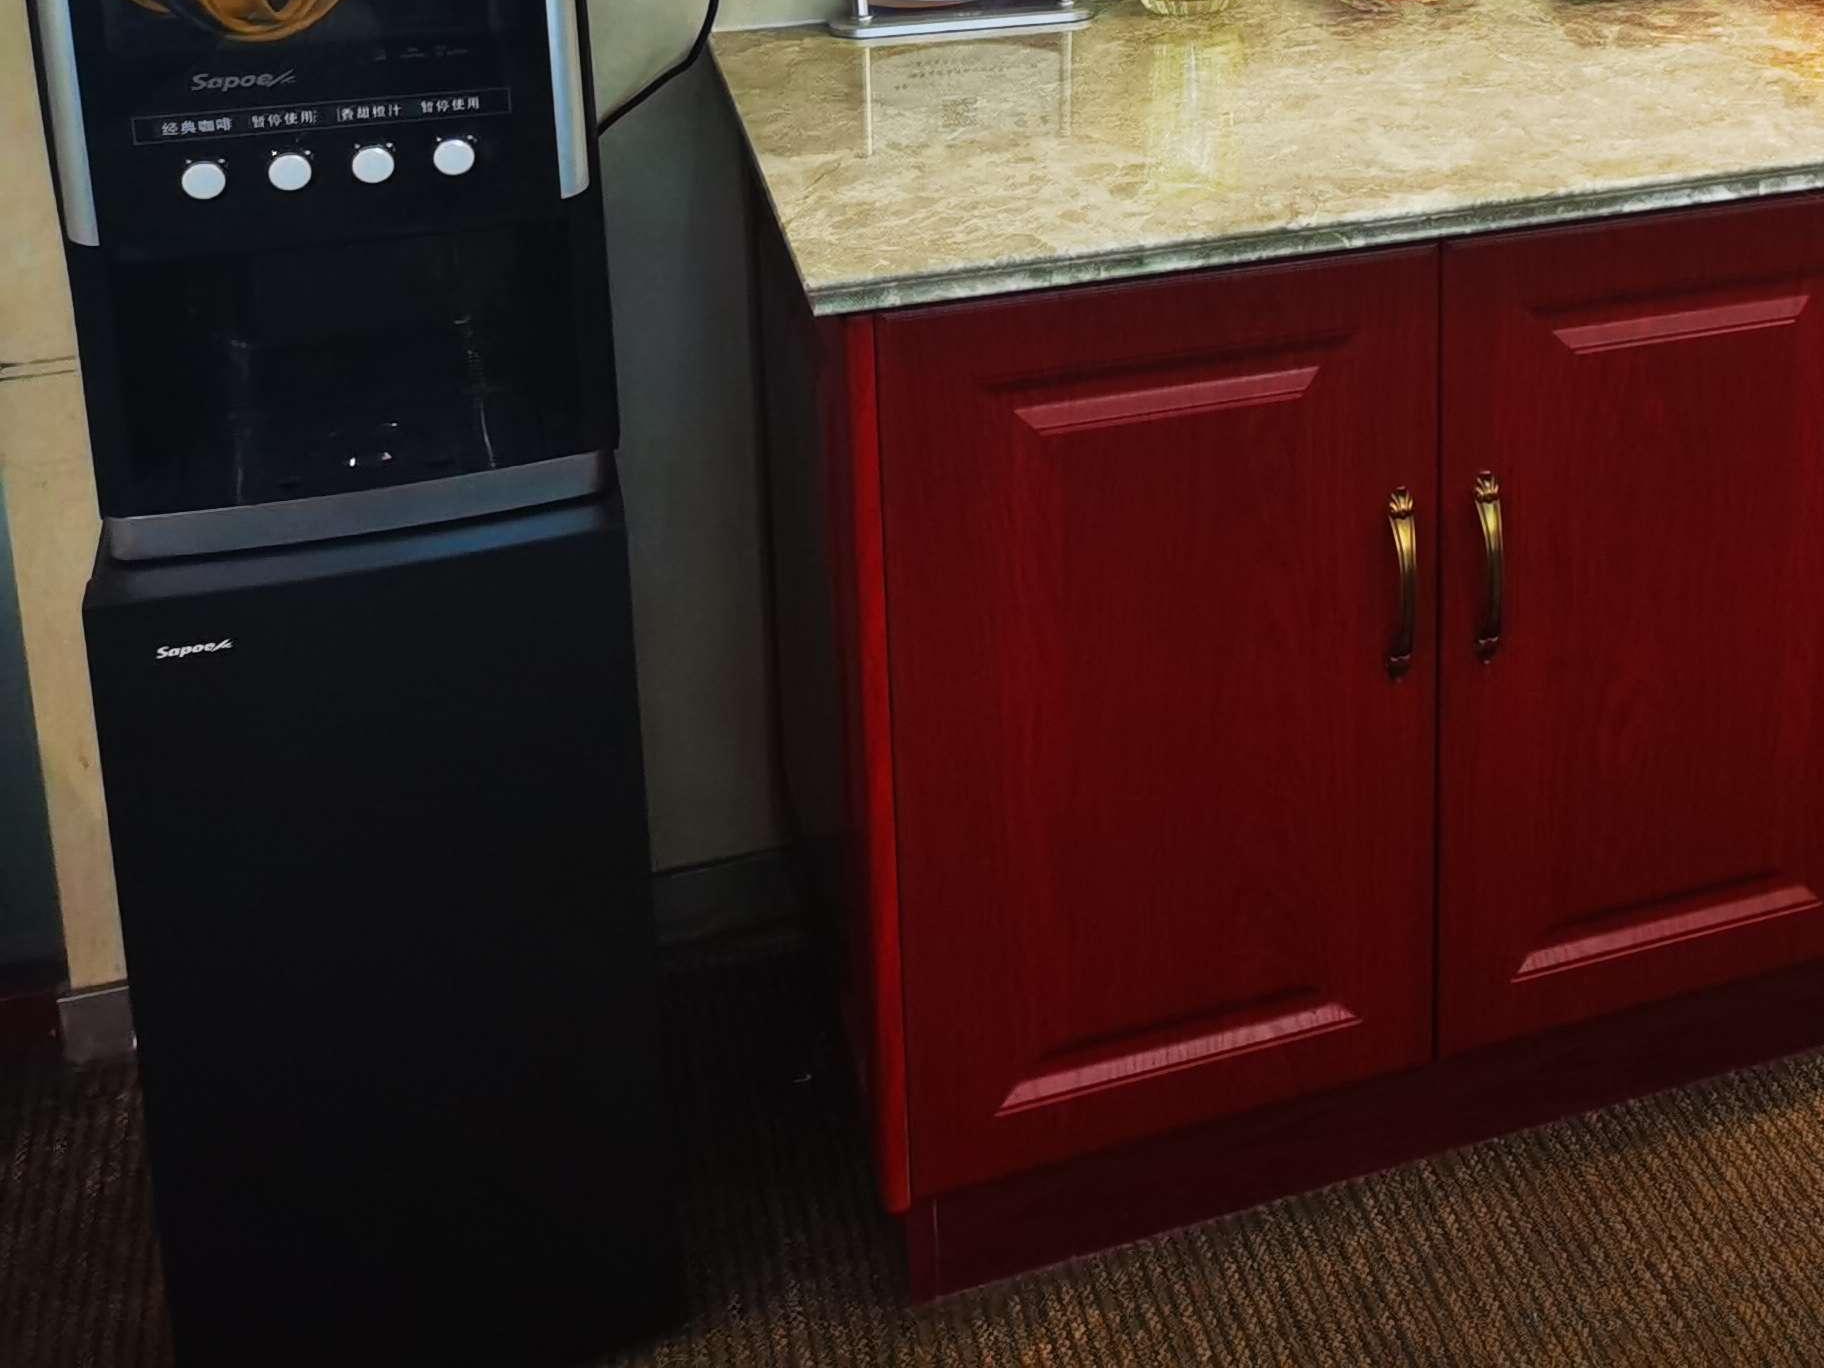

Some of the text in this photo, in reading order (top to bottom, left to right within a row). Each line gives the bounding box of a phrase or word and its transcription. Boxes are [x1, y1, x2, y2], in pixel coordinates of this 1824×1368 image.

[161, 117, 233, 137] 经典咖啡
[251, 109, 314, 129] 暂停使用
[419, 96, 480, 114] 暂停使用
